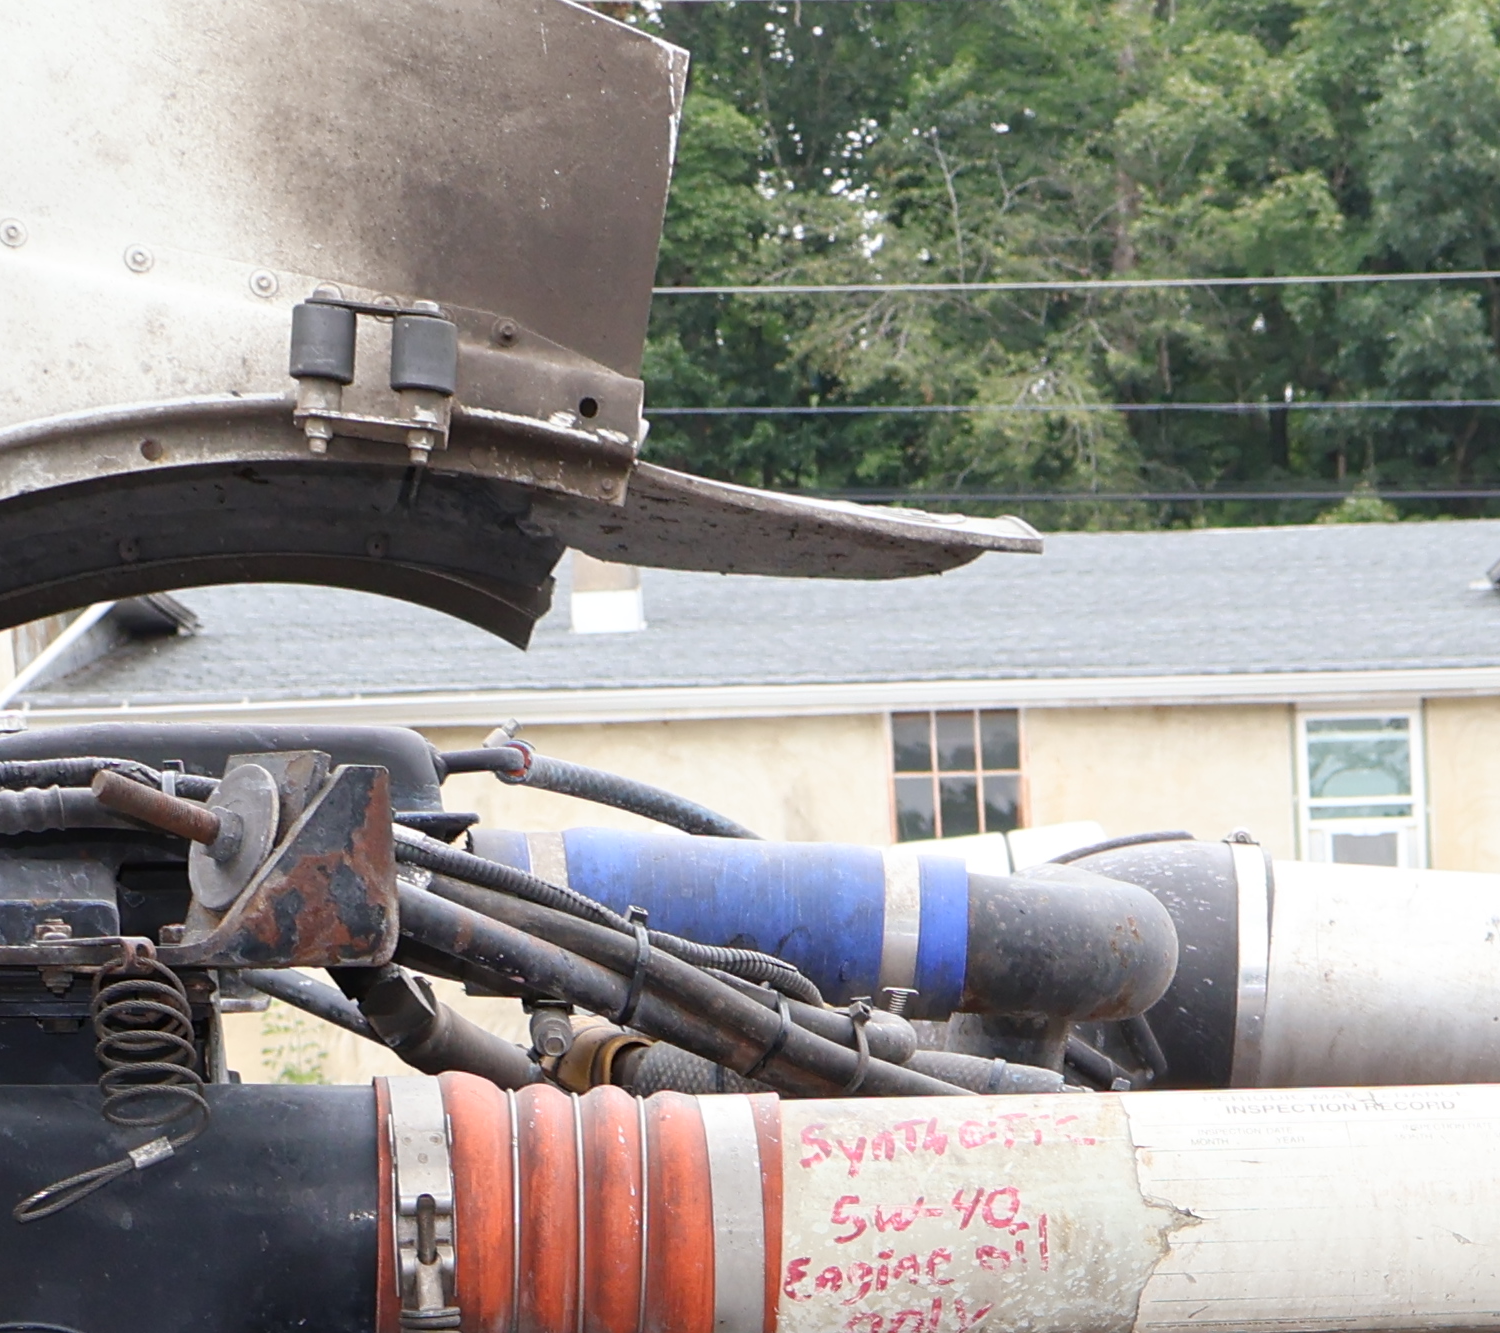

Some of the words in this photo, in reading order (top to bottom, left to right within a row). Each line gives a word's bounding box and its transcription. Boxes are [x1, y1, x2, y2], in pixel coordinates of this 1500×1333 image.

[1224, 1103, 1358, 1115] INSPECTION
[1362, 1099, 1458, 1113] RECORD
[1197, 1127, 1262, 1137] INSPECTION
[1265, 1126, 1293, 1135] DATE
[1190, 1137, 1230, 1147] MONTH
[1275, 1136, 1306, 1145] YEAR
